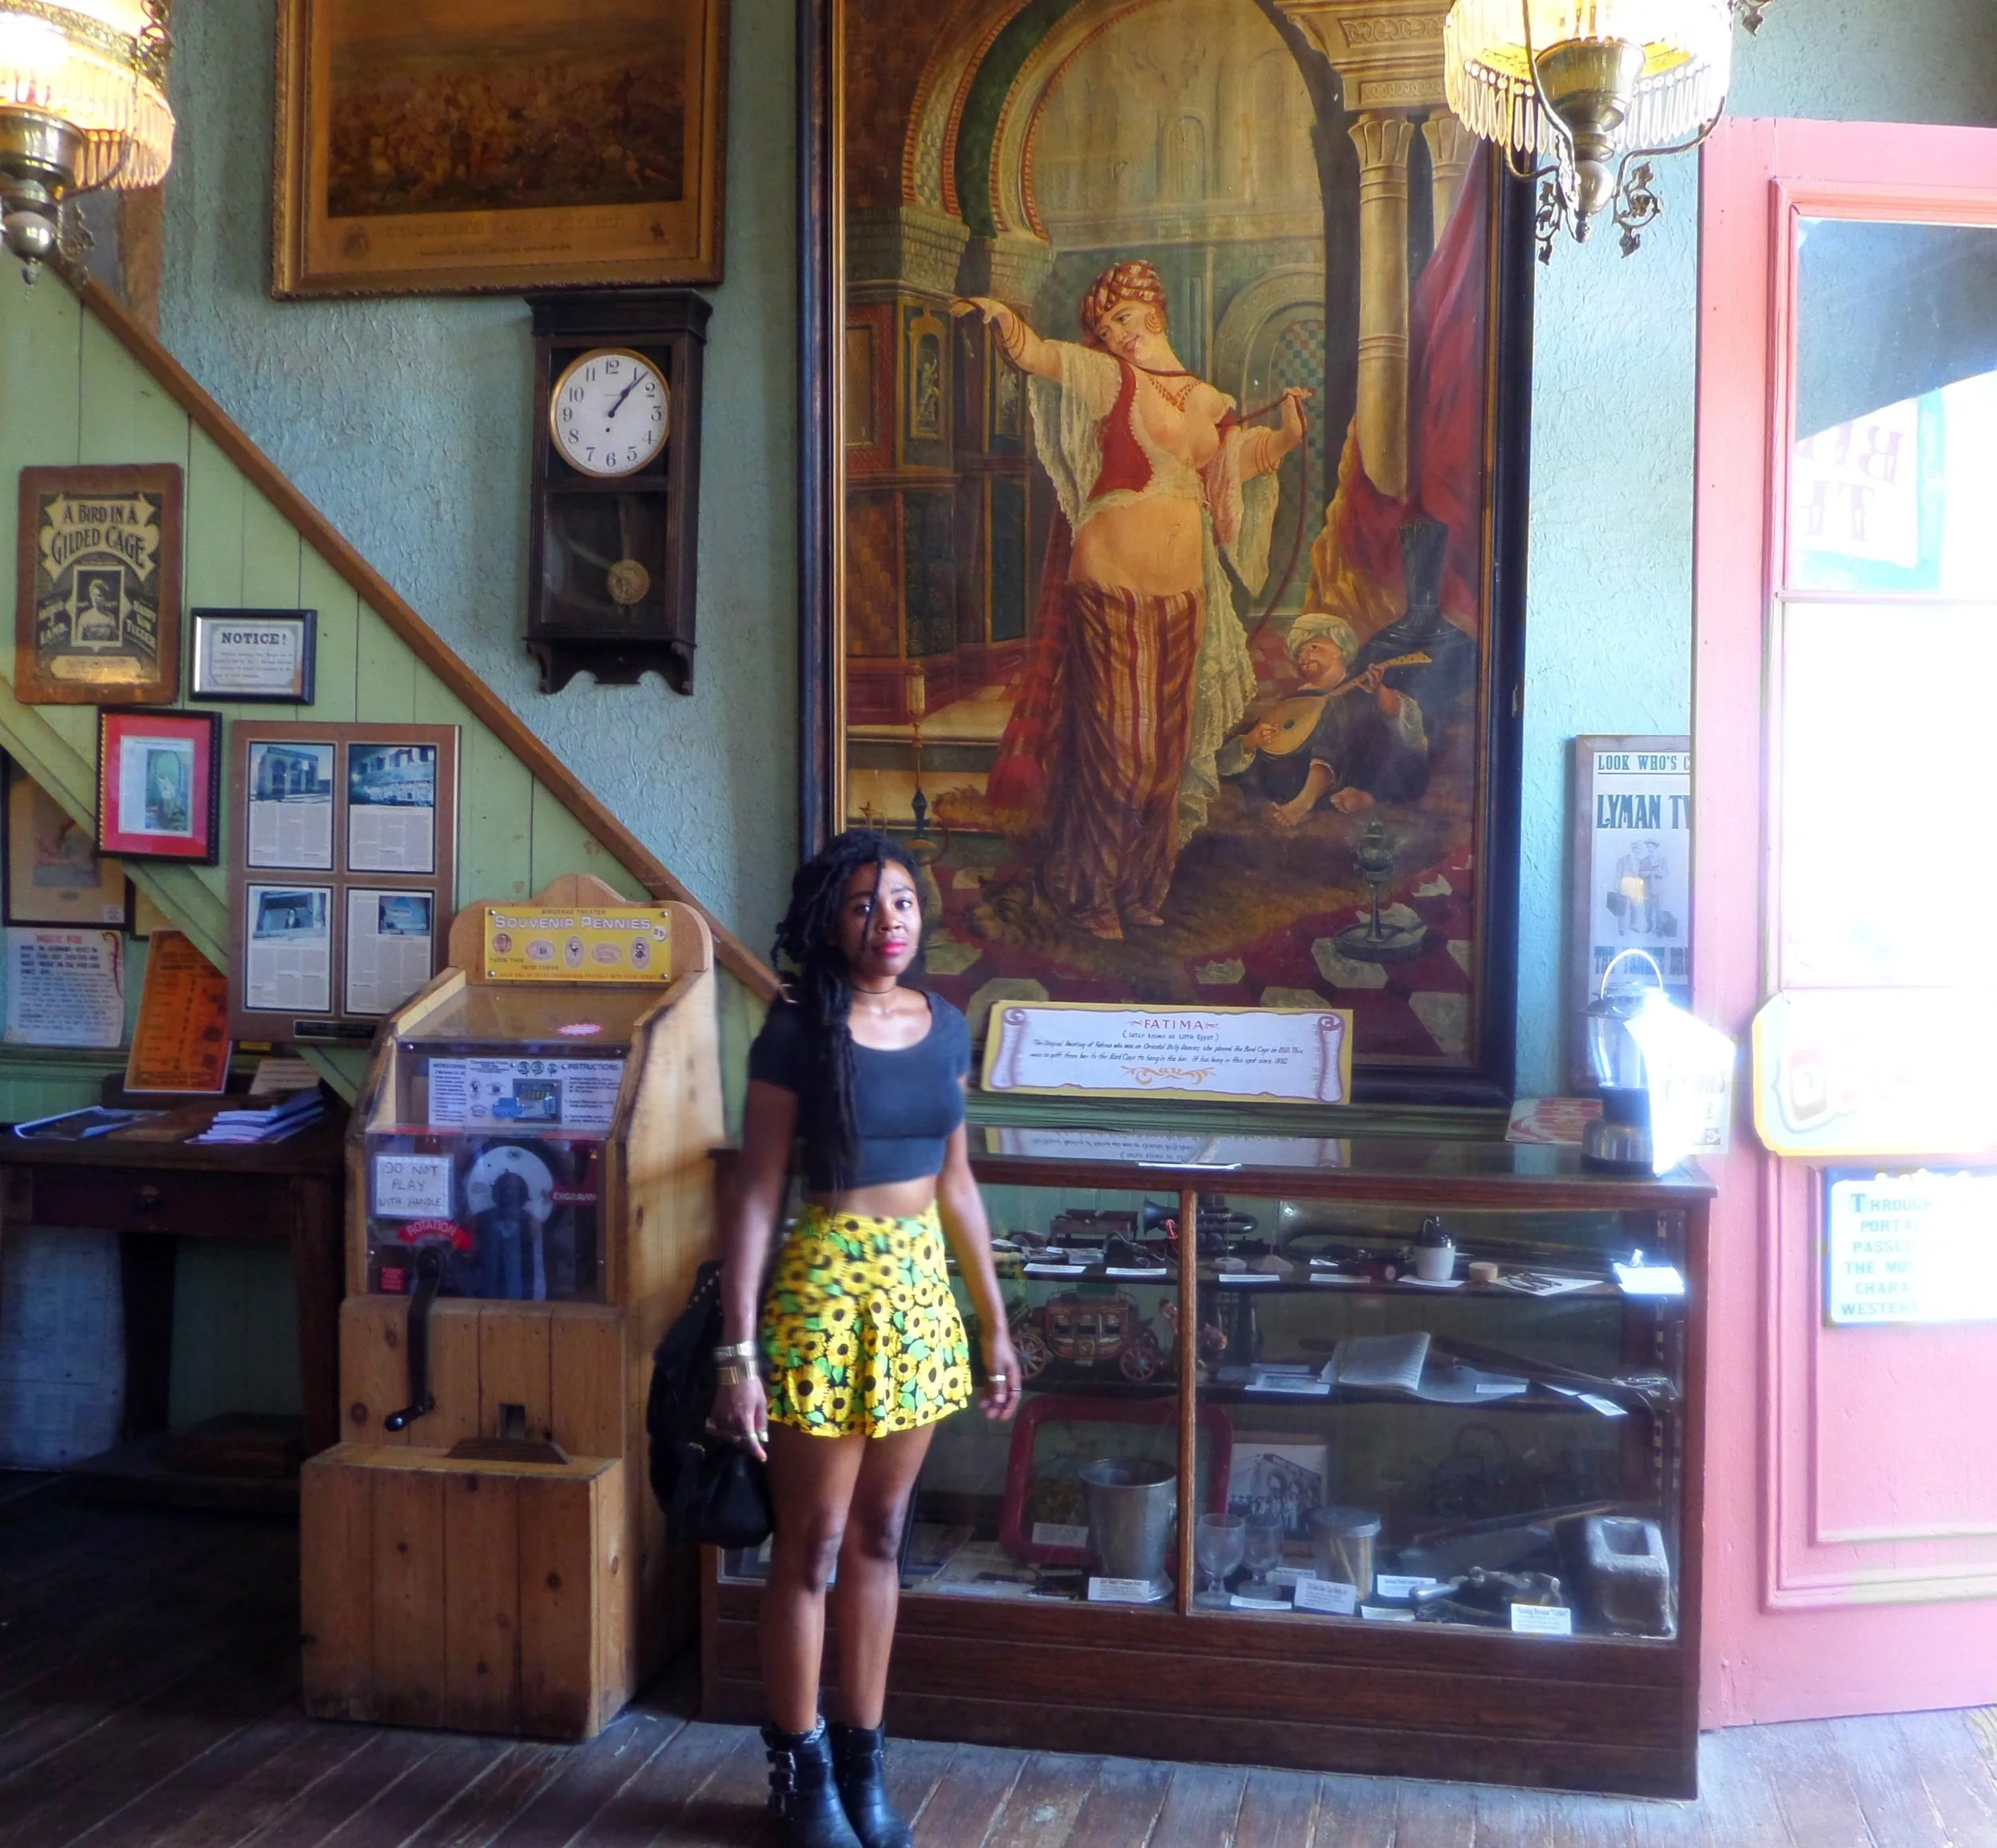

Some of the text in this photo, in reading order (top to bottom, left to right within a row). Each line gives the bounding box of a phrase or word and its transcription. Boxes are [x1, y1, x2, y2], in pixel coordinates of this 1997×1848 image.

[586, 368, 596, 382] 11
[605, 360, 620, 375] 12
[569, 386, 584, 403] 10
[645, 382, 656, 398] 2
[562, 407, 573, 423] 9
[651, 405, 662, 422] 3
[568, 427, 579, 444] 8
[641, 430, 655, 444] 4
[586, 447, 596, 462] 7
[605, 451, 617, 467] 6
[627, 446, 637, 462] 5
[63, 503, 138, 524] A BIRD IN A
[50, 526, 145, 567] GILDED CAGE
[1598, 754, 1630, 771] LOOK
[1638, 754, 1677, 771] WHO'S
[1596, 794, 1662, 829] LYMAN
[494, 915, 652, 930] SOUVENIR PENNIES
[1144, 1019, 1203, 1030] FATIMA
[383, 1162, 438, 1178] DO NOT
[391, 1178, 426, 1191] PLAY
[406, 1221, 457, 1238] ROTATION
[1844, 1261, 1876, 1274] THE
